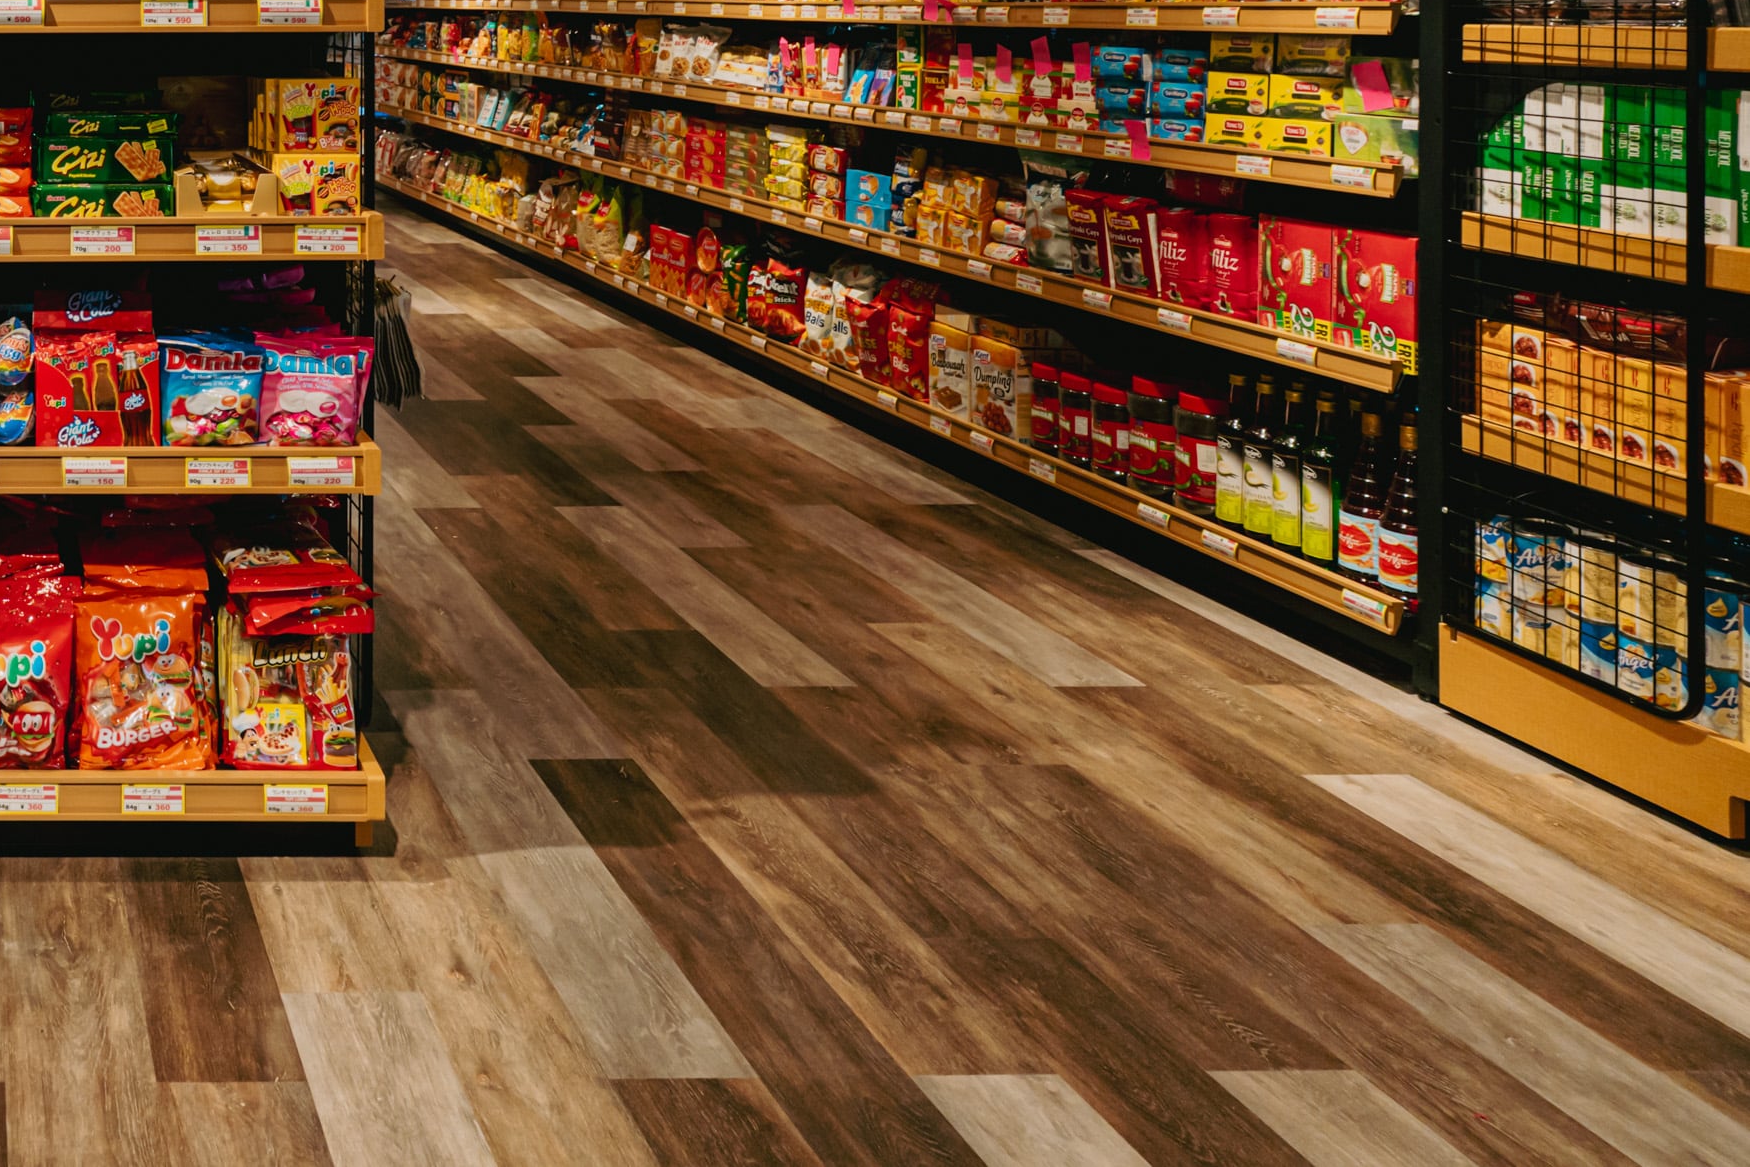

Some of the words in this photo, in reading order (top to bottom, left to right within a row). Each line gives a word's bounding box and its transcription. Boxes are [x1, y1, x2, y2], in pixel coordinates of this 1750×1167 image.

[175, 16, 191, 24] 590
[290, 16, 307, 24] 590
[304, 83, 336, 100] Yupi
[51, 146, 105, 176] Çizi
[303, 160, 335, 176] Yupi
[231, 244, 248, 252] 350
[1159, 241, 1187, 262] filiz
[1212, 246, 1239, 271] filiz
[165, 347, 262, 373] Damla
[262, 351, 353, 376] Damla
[974, 369, 1012, 392] Dumpling
[42, 394, 67, 409] Yupi
[220, 477, 235, 485] 220
[90, 615, 171, 664] Yupi
[252, 636, 329, 668] Lunch
[97, 719, 179, 750] BURGER
[27, 803, 43, 811] 360
[155, 803, 170, 811] 360
